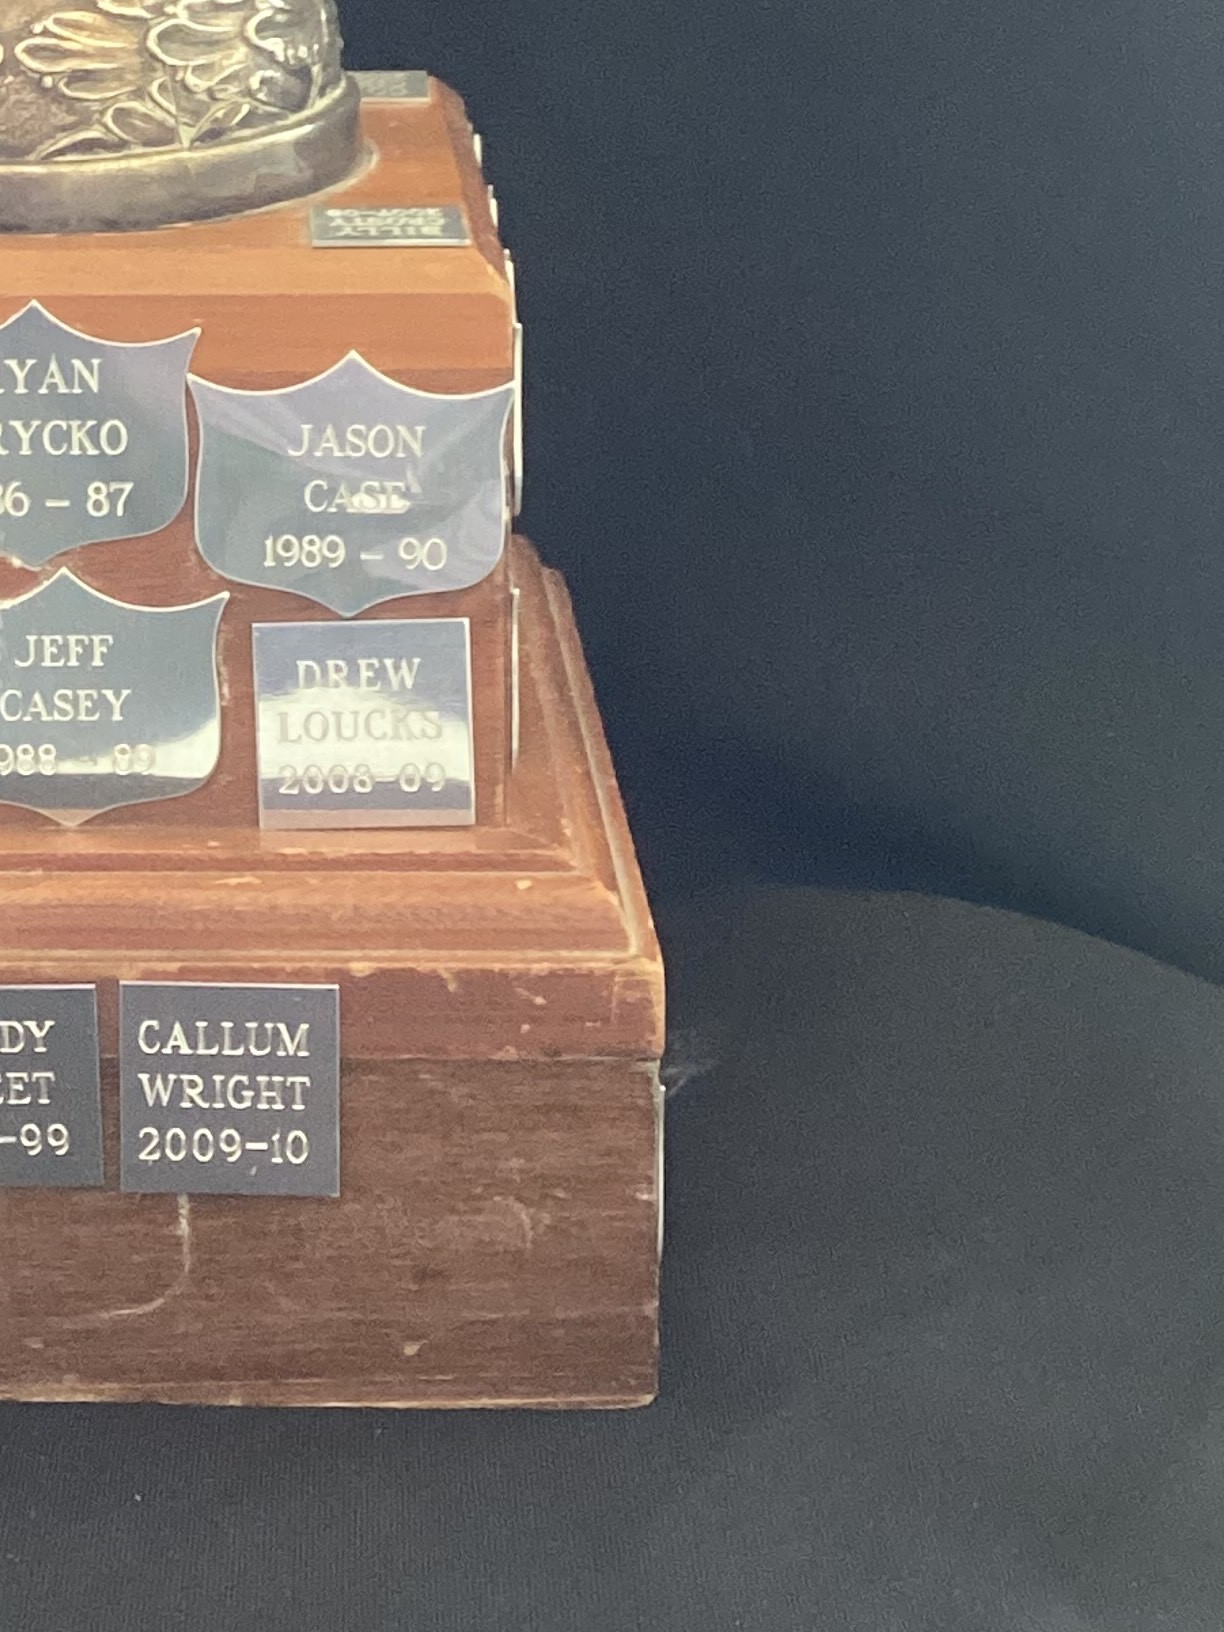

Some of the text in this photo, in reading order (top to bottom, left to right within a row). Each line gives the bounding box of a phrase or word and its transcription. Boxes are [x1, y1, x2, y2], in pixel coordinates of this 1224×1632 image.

[287, 423, 426, 458] JASON
[85, 481, 134, 517] 87
[303, 479, 410, 514] CASE
[263, 533, 346, 568] 1989
[397, 536, 448, 571] 90
[14, 633, 114, 668] JEFF
[295, 657, 422, 691] DREW
[277, 708, 444, 744] LOUCKS
[137, 1019, 311, 1057] CALLUM
[137, 1072, 312, 1111] WRIGHT
[137, 1126, 310, 1165] 2009-10
